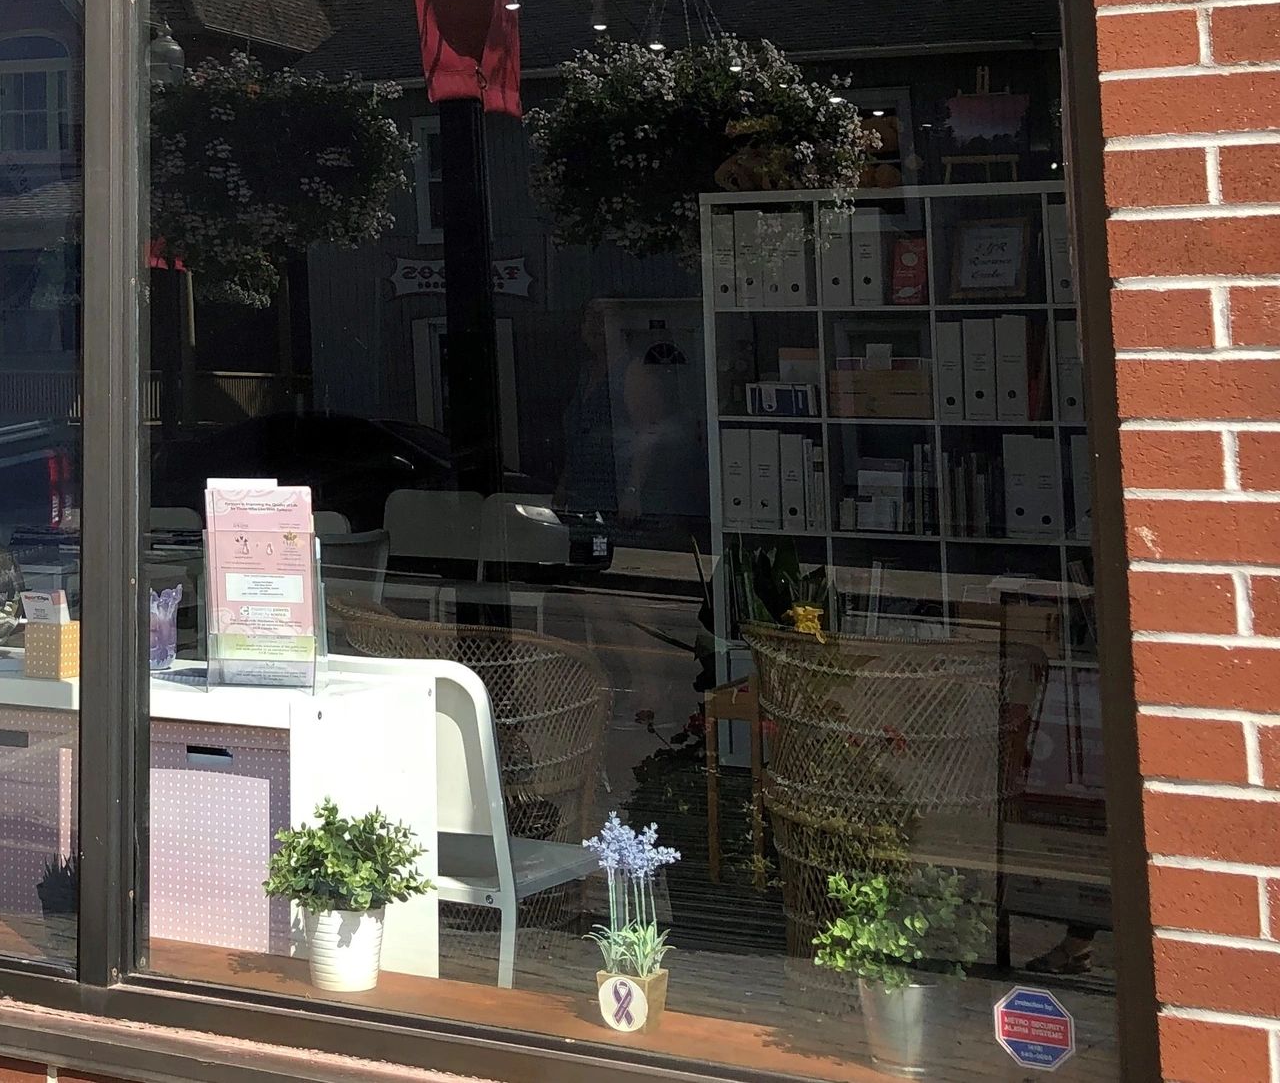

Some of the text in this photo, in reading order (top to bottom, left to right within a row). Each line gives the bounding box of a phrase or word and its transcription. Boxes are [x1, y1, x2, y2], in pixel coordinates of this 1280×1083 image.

[1014, 1000, 1054, 1011] protection by
[1004, 1016, 1065, 1032] METRO SECURITY
[1004, 1024, 1065, 1040] ALARM SYSTEMS
